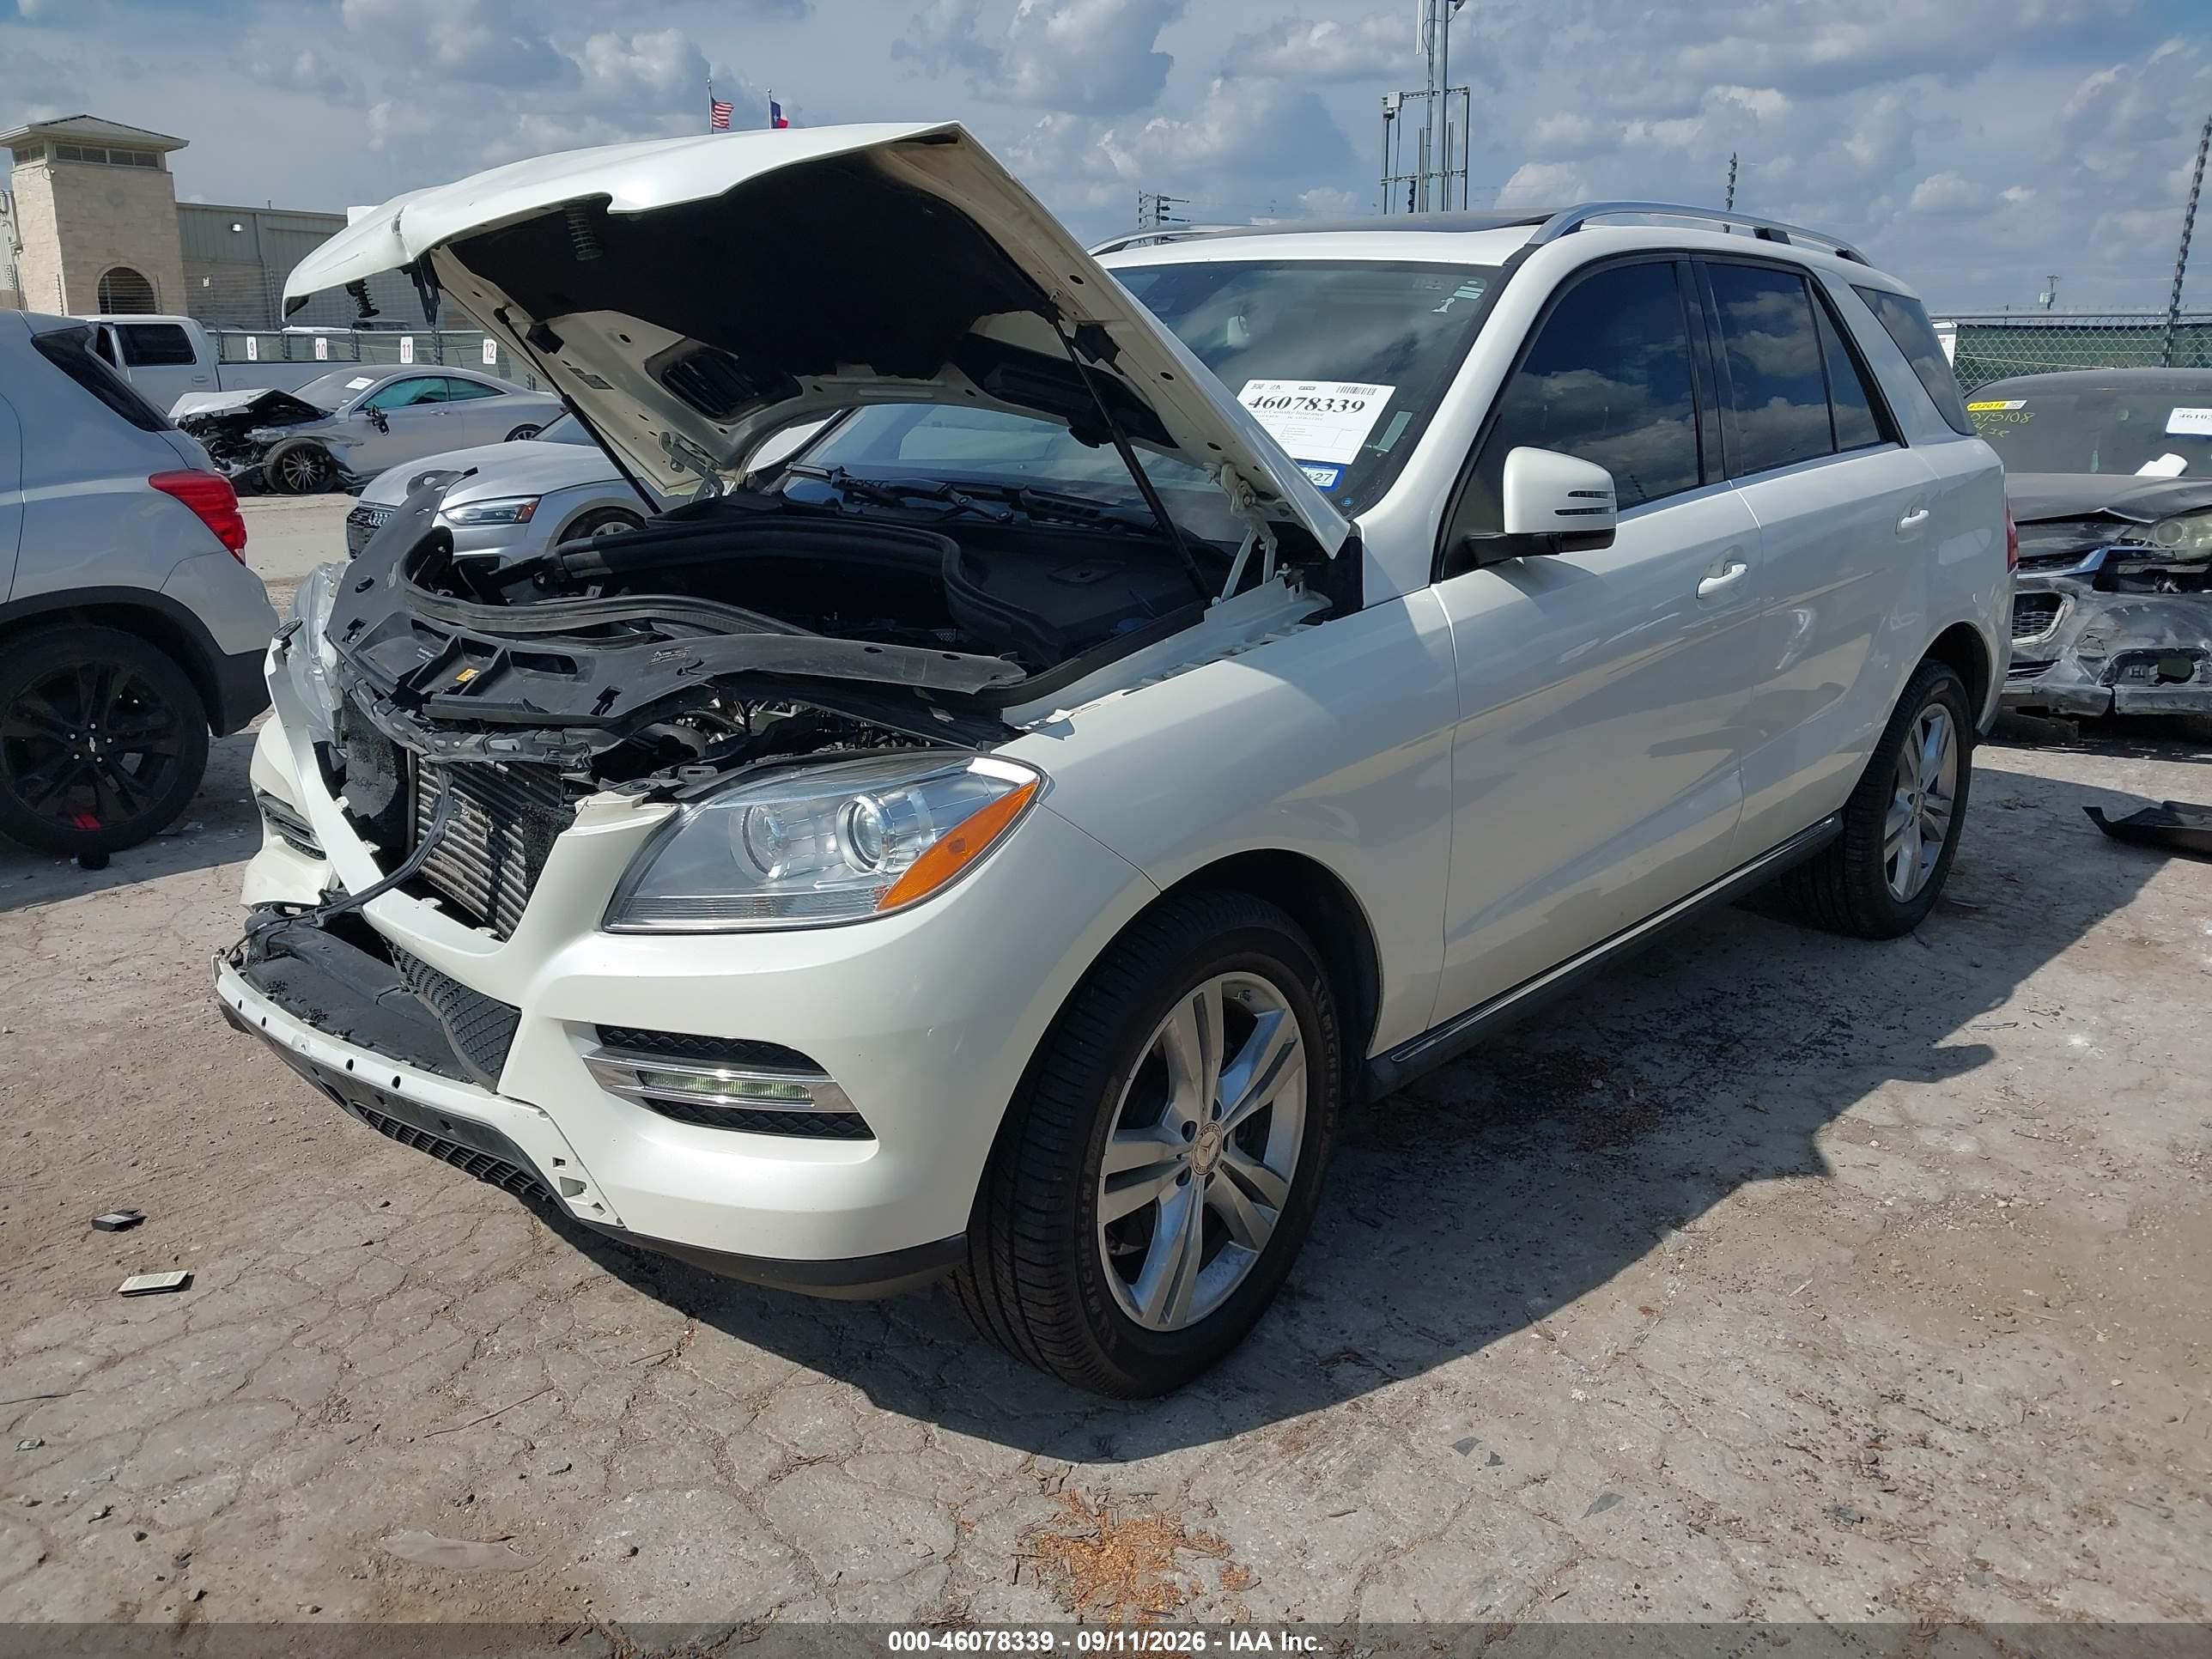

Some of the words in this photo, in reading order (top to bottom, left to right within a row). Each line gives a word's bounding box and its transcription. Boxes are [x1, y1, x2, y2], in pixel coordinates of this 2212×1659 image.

[249, 342, 255, 356] 9
[316, 343, 326, 358] 10
[403, 343, 410, 358] 11
[485, 343, 495, 358] 12
[1249, 396, 1365, 414] 46078339
[1314, 472, 1334, 482] 27
